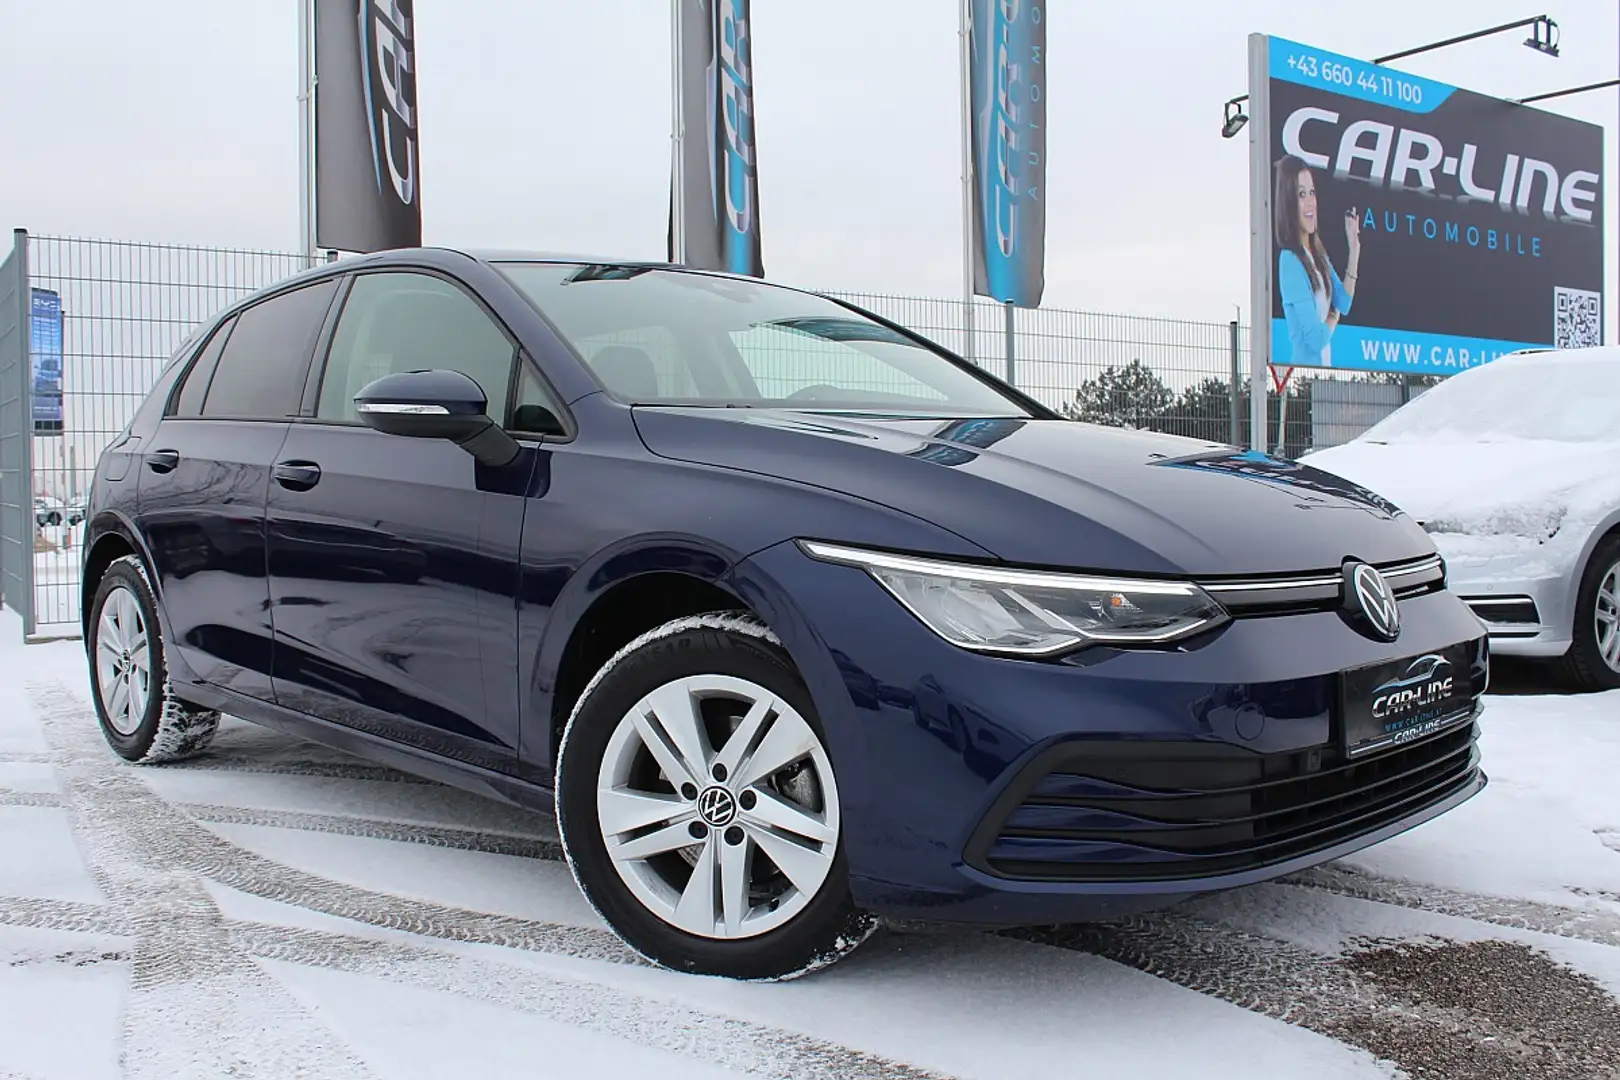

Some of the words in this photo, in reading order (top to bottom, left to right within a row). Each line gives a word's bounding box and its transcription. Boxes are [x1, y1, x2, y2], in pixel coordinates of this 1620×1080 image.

[1287, 54, 1318, 78] +43
[1321, 62, 1353, 87] 660
[1357, 71, 1379, 94] 44
[1381, 76, 1394, 97] 11
[1396, 80, 1423, 104] 100
[1282, 106, 1600, 220] CAR-LINE
[1363, 207, 1542, 258] AUTOMOBILE
[1360, 339, 1507, 369] WWW.CAR-L
[1372, 676, 1453, 718] CAR-LINE
